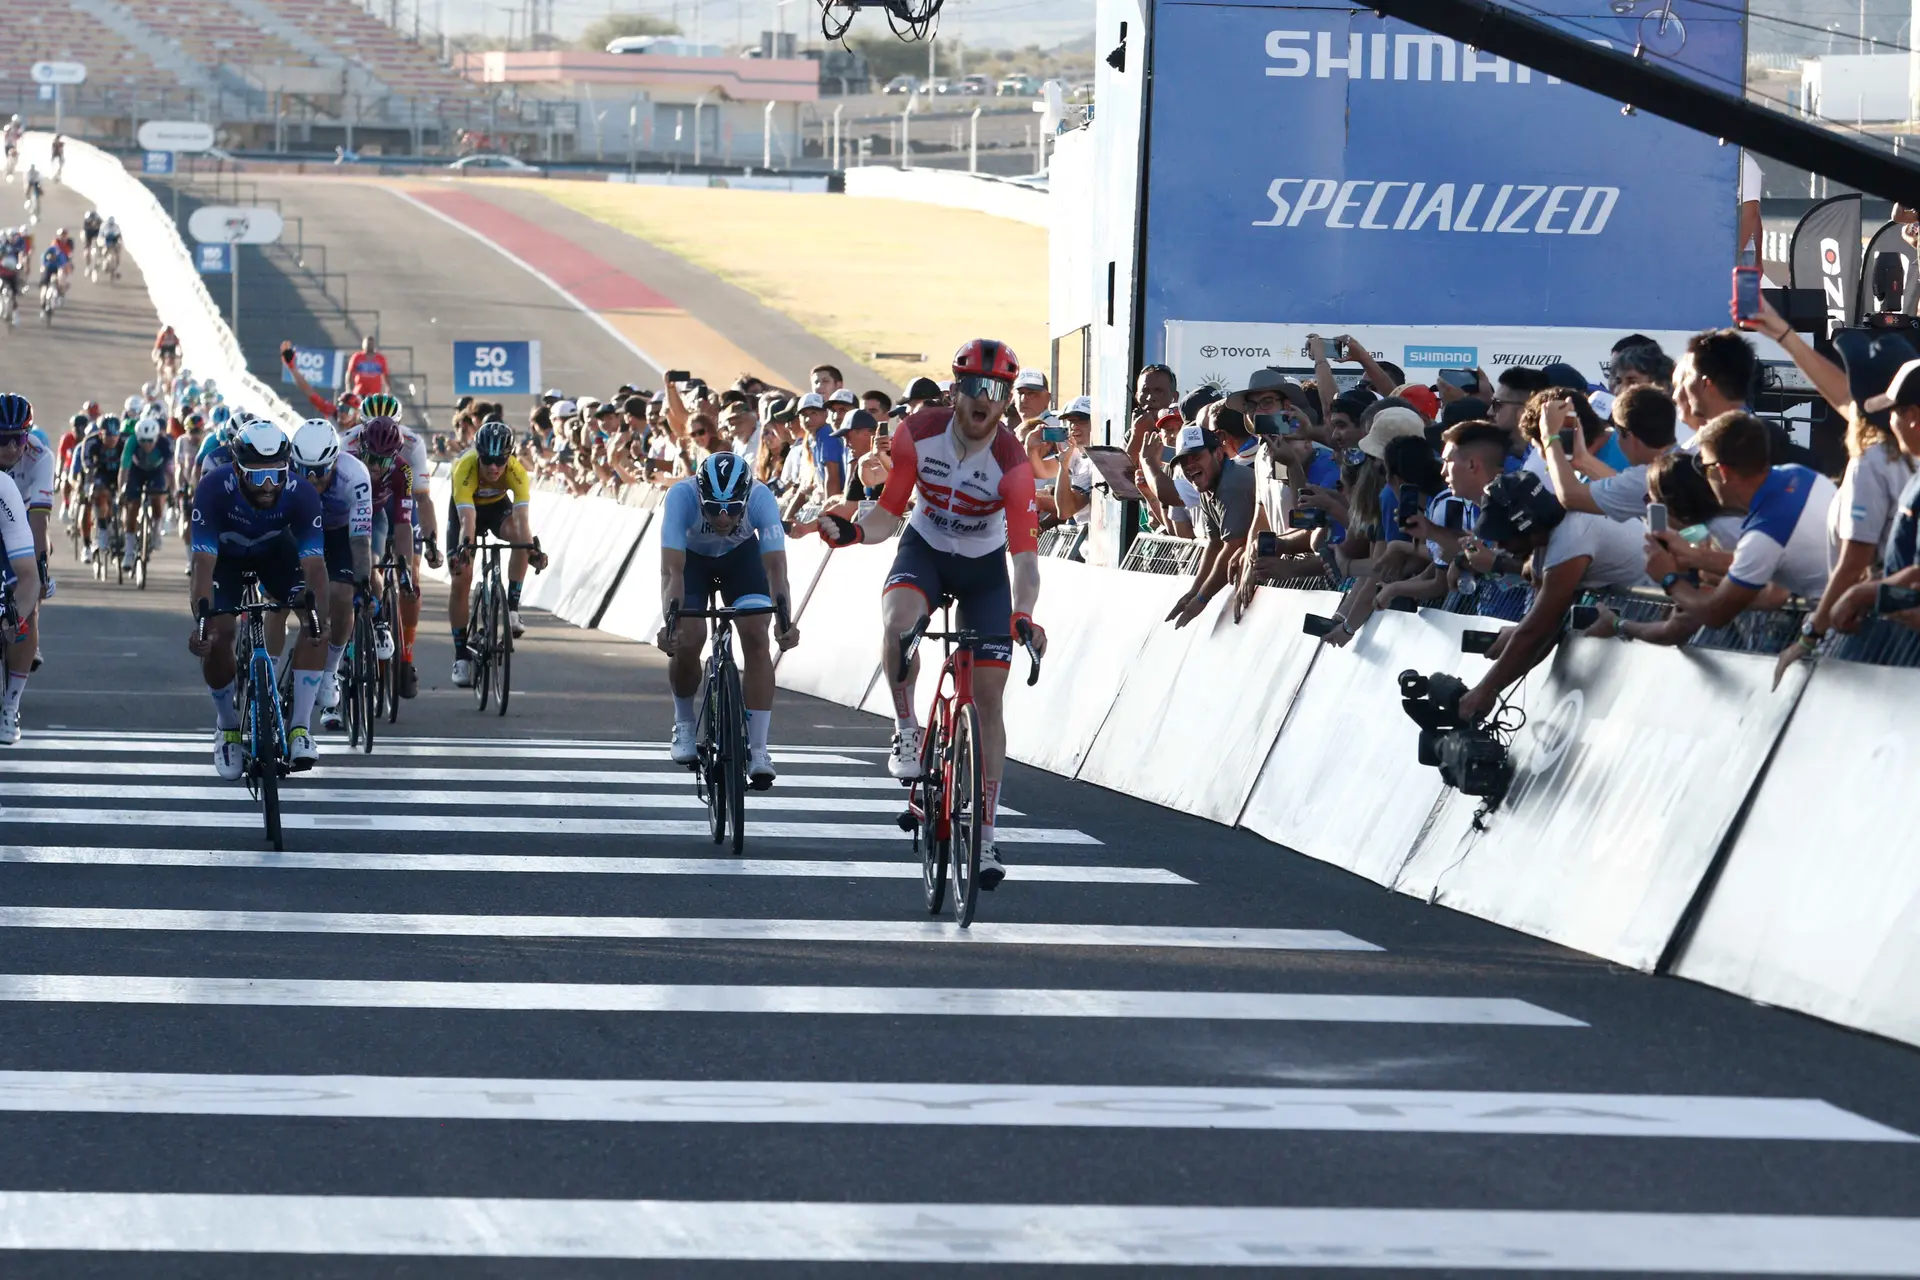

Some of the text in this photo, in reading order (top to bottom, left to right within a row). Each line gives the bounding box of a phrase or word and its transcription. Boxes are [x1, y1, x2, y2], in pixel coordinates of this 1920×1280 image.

[1252, 178, 1620, 235] SPECIALIZED
[475, 347, 507, 367] 50
[1221, 347, 1271, 358] TOYOTA
[1410, 351, 1472, 363] SHIMANO
[296, 351, 325, 369] 100
[1490, 353, 1562, 366] SPECIALIZED
[468, 368, 515, 387] mts
[924, 456, 950, 470] SRAM
[921, 466, 949, 478] Santini
[982, 643, 1010, 652] Santini
